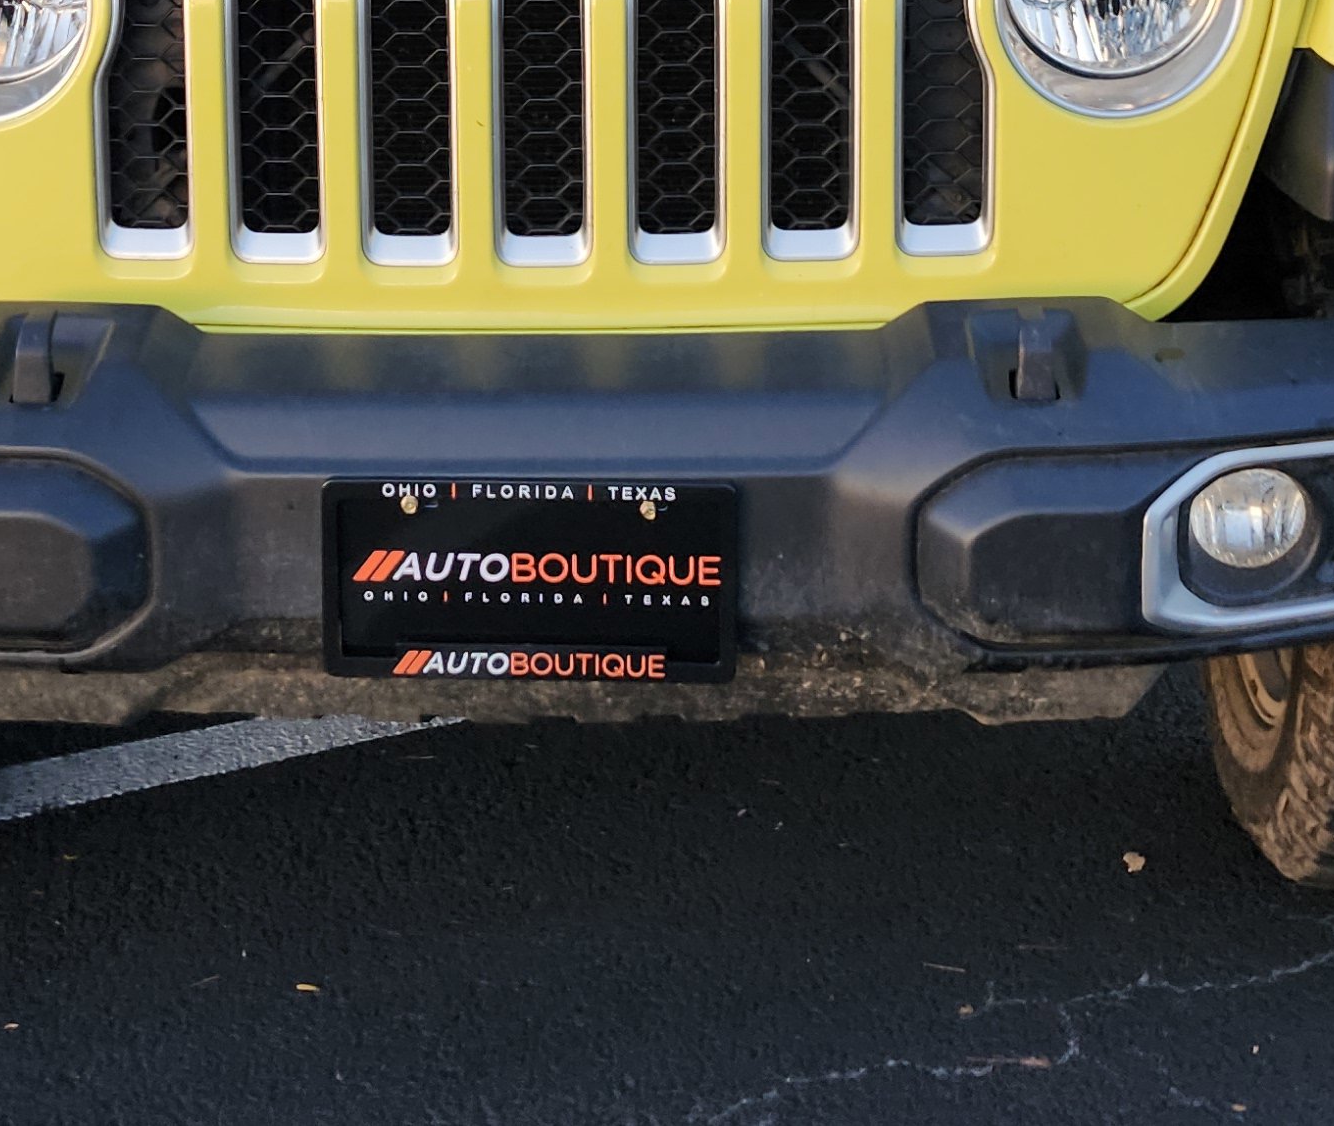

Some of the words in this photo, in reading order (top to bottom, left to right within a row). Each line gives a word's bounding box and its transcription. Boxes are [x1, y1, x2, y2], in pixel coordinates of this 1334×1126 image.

[381, 482, 437, 498] OHIO
[472, 484, 575, 500] FLORIDA
[608, 486, 677, 502] TEXAS
[363, 590, 429, 603] OHIO
[464, 591, 584, 605] FLORIDA
[624, 594, 710, 607] TEXAS
